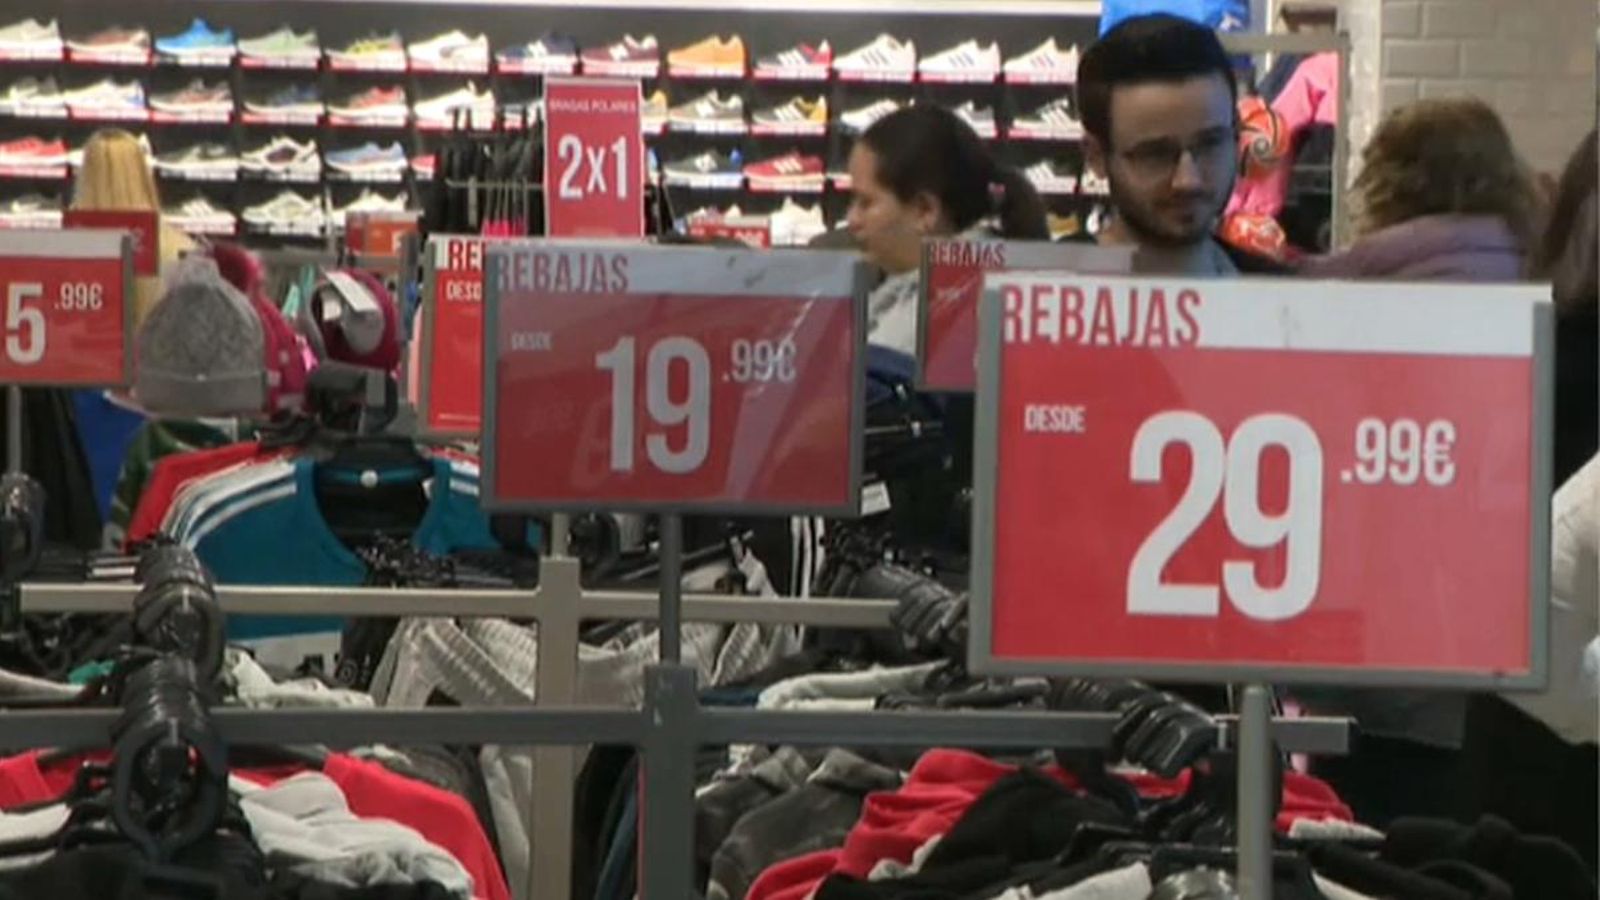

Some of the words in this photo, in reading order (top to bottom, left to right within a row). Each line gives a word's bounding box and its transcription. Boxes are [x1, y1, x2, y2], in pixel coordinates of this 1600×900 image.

[558, 133, 628, 200] 2x1
[496, 252, 630, 293] REBAJAS
[928, 241, 1006, 267] REBAJAS
[1001, 284, 1202, 348] REBAJAS
[595, 336, 711, 475] 19
[1024, 403, 1087, 433] DESDE
[1126, 410, 1325, 622] 29
[1341, 418, 1457, 487] .99€
